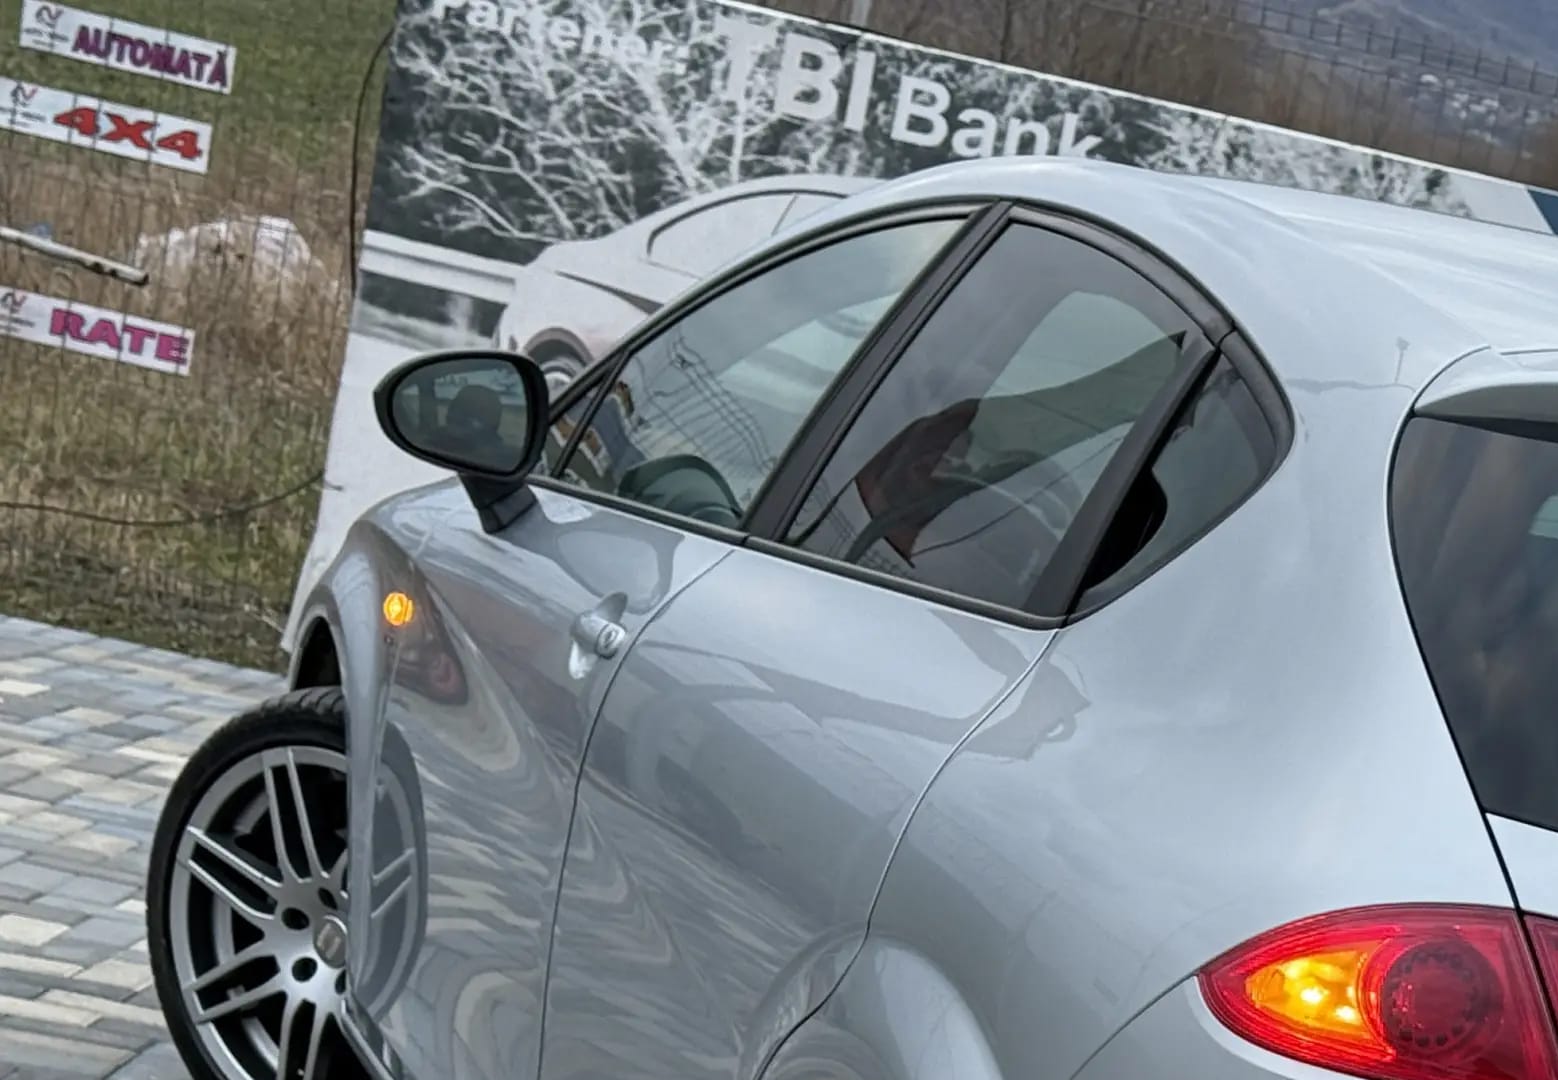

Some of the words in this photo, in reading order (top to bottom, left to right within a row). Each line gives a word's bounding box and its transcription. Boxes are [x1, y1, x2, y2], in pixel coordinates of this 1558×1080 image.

[714, 16, 877, 132] TBI
[890, 77, 1102, 158] Bank
[49, 308, 189, 364] RATE
